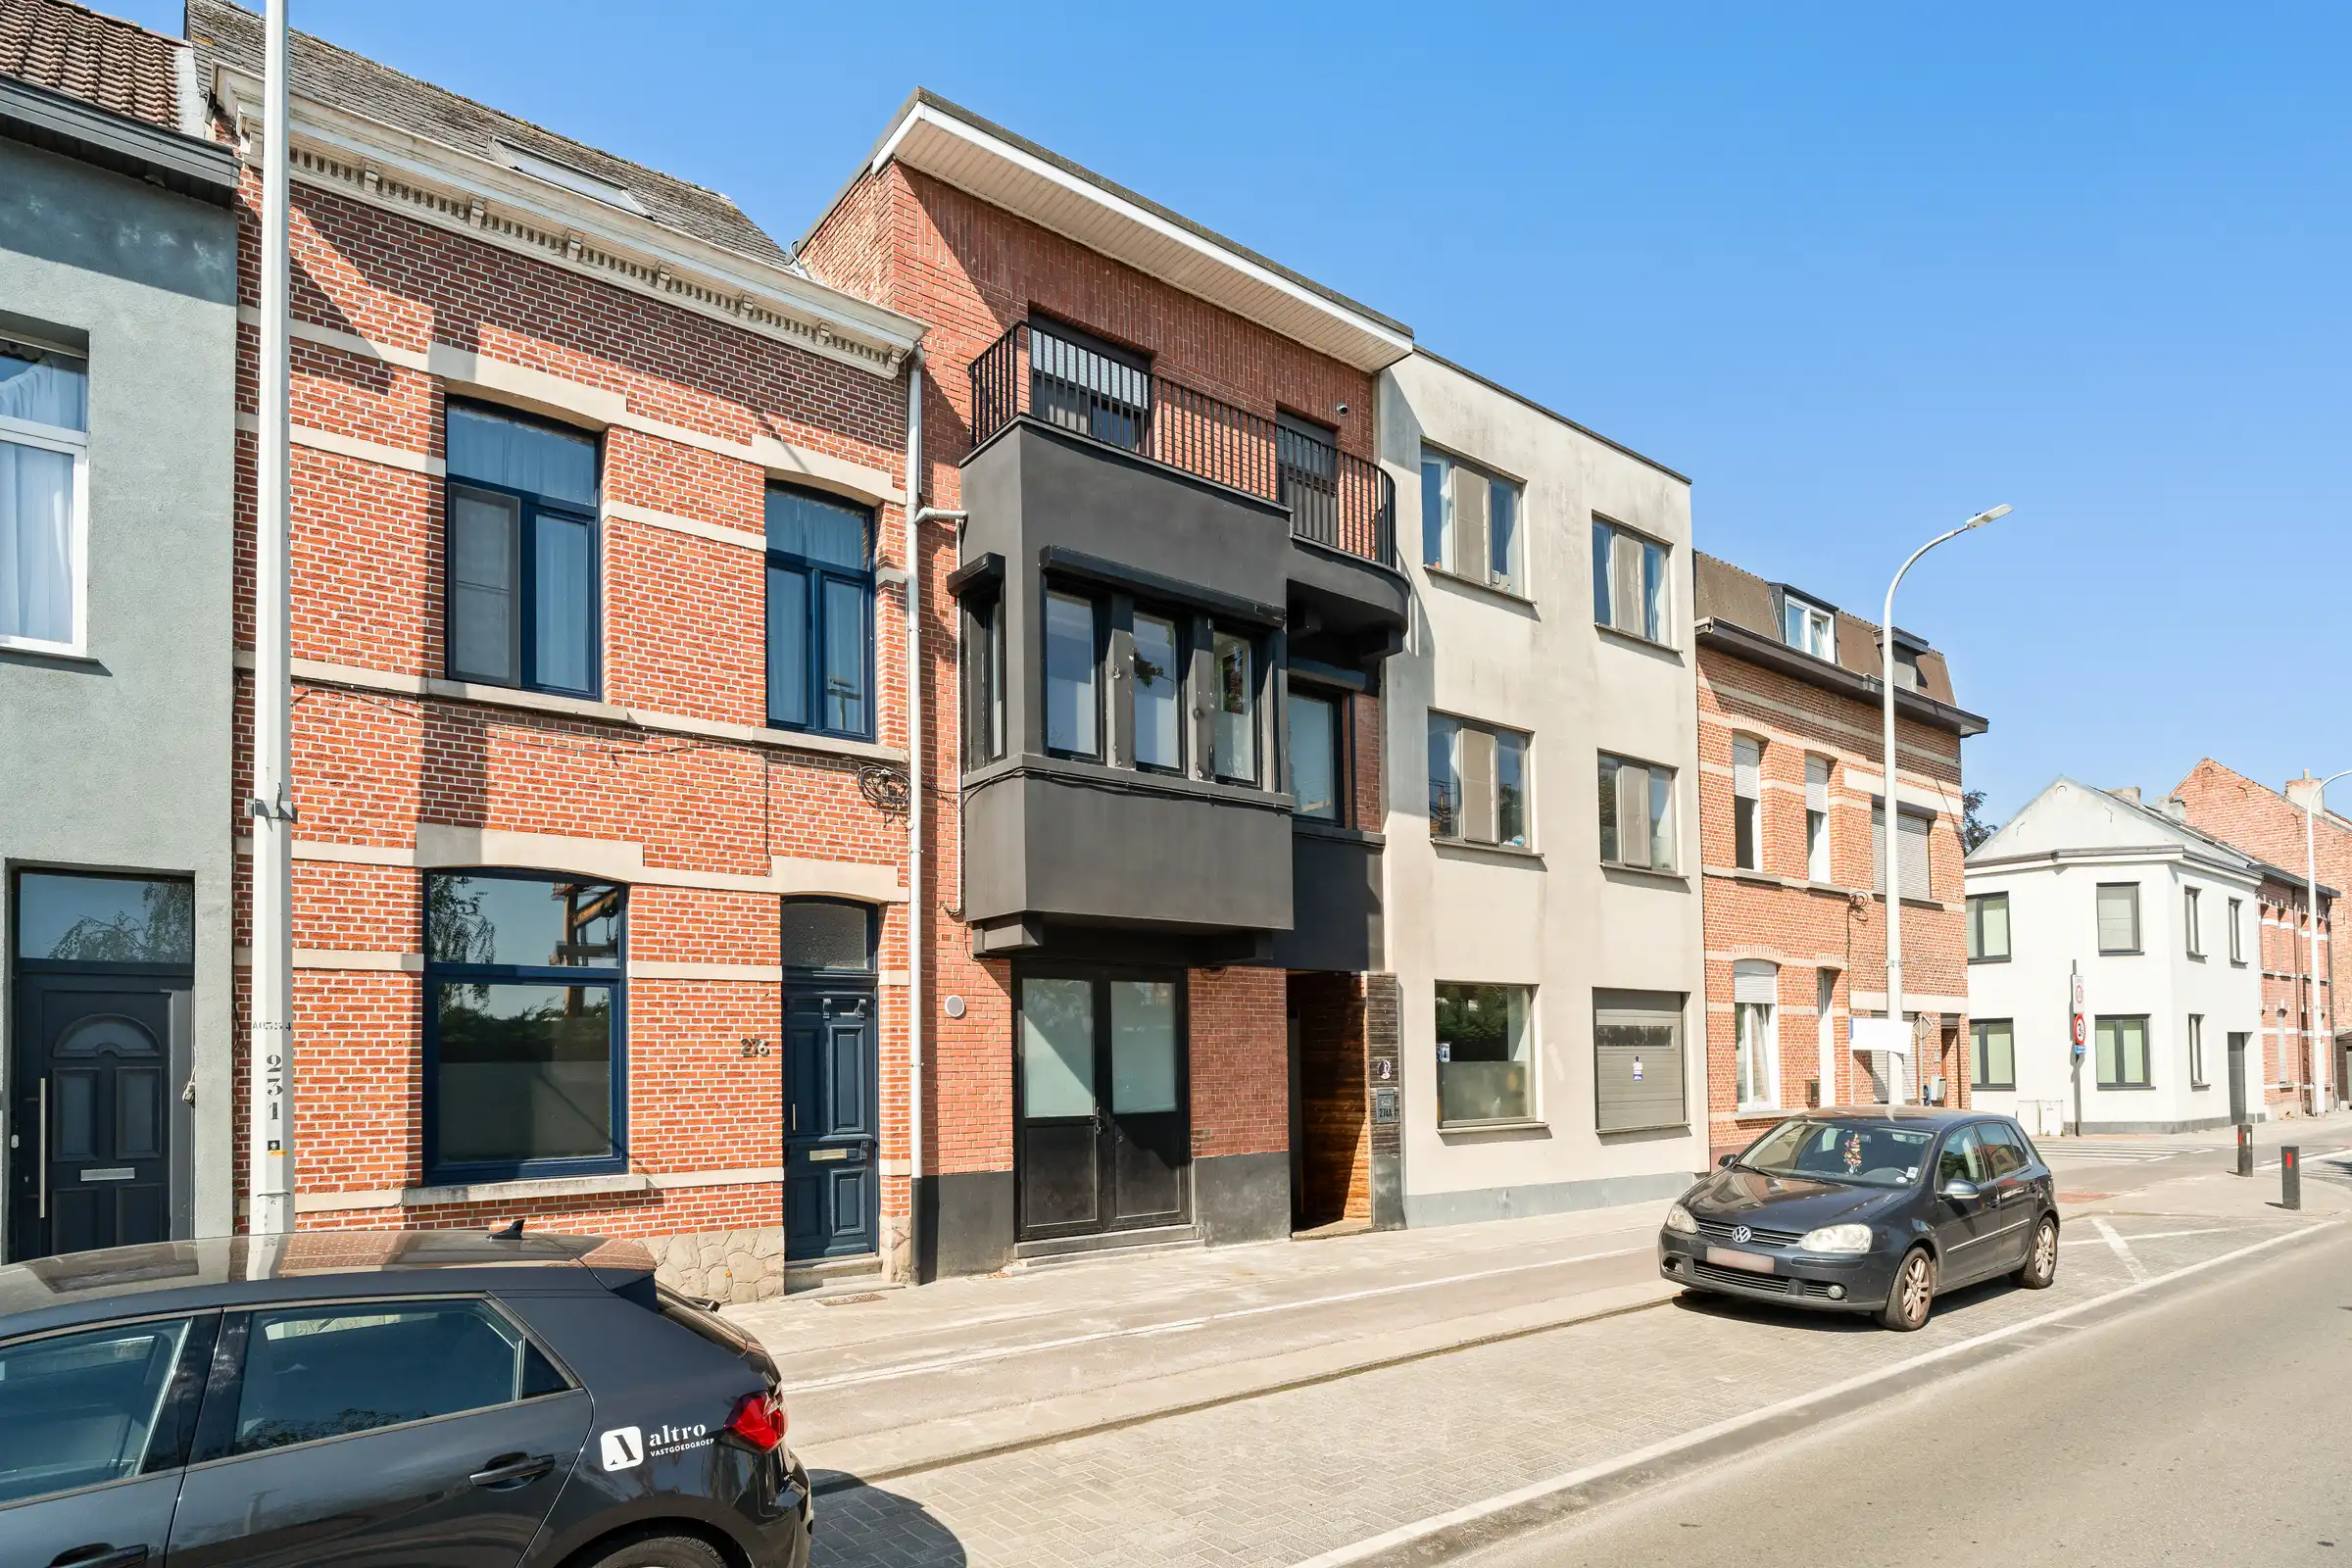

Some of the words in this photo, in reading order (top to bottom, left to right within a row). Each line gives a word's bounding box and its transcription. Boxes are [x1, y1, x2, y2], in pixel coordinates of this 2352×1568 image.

[741, 1038, 770, 1057] 276
[266, 1054, 283, 1120] 231
[1379, 1107, 1393, 1118] 274A
[649, 1424, 707, 1447] altro
[650, 1438, 714, 1457] VASTGOEDGROEP
